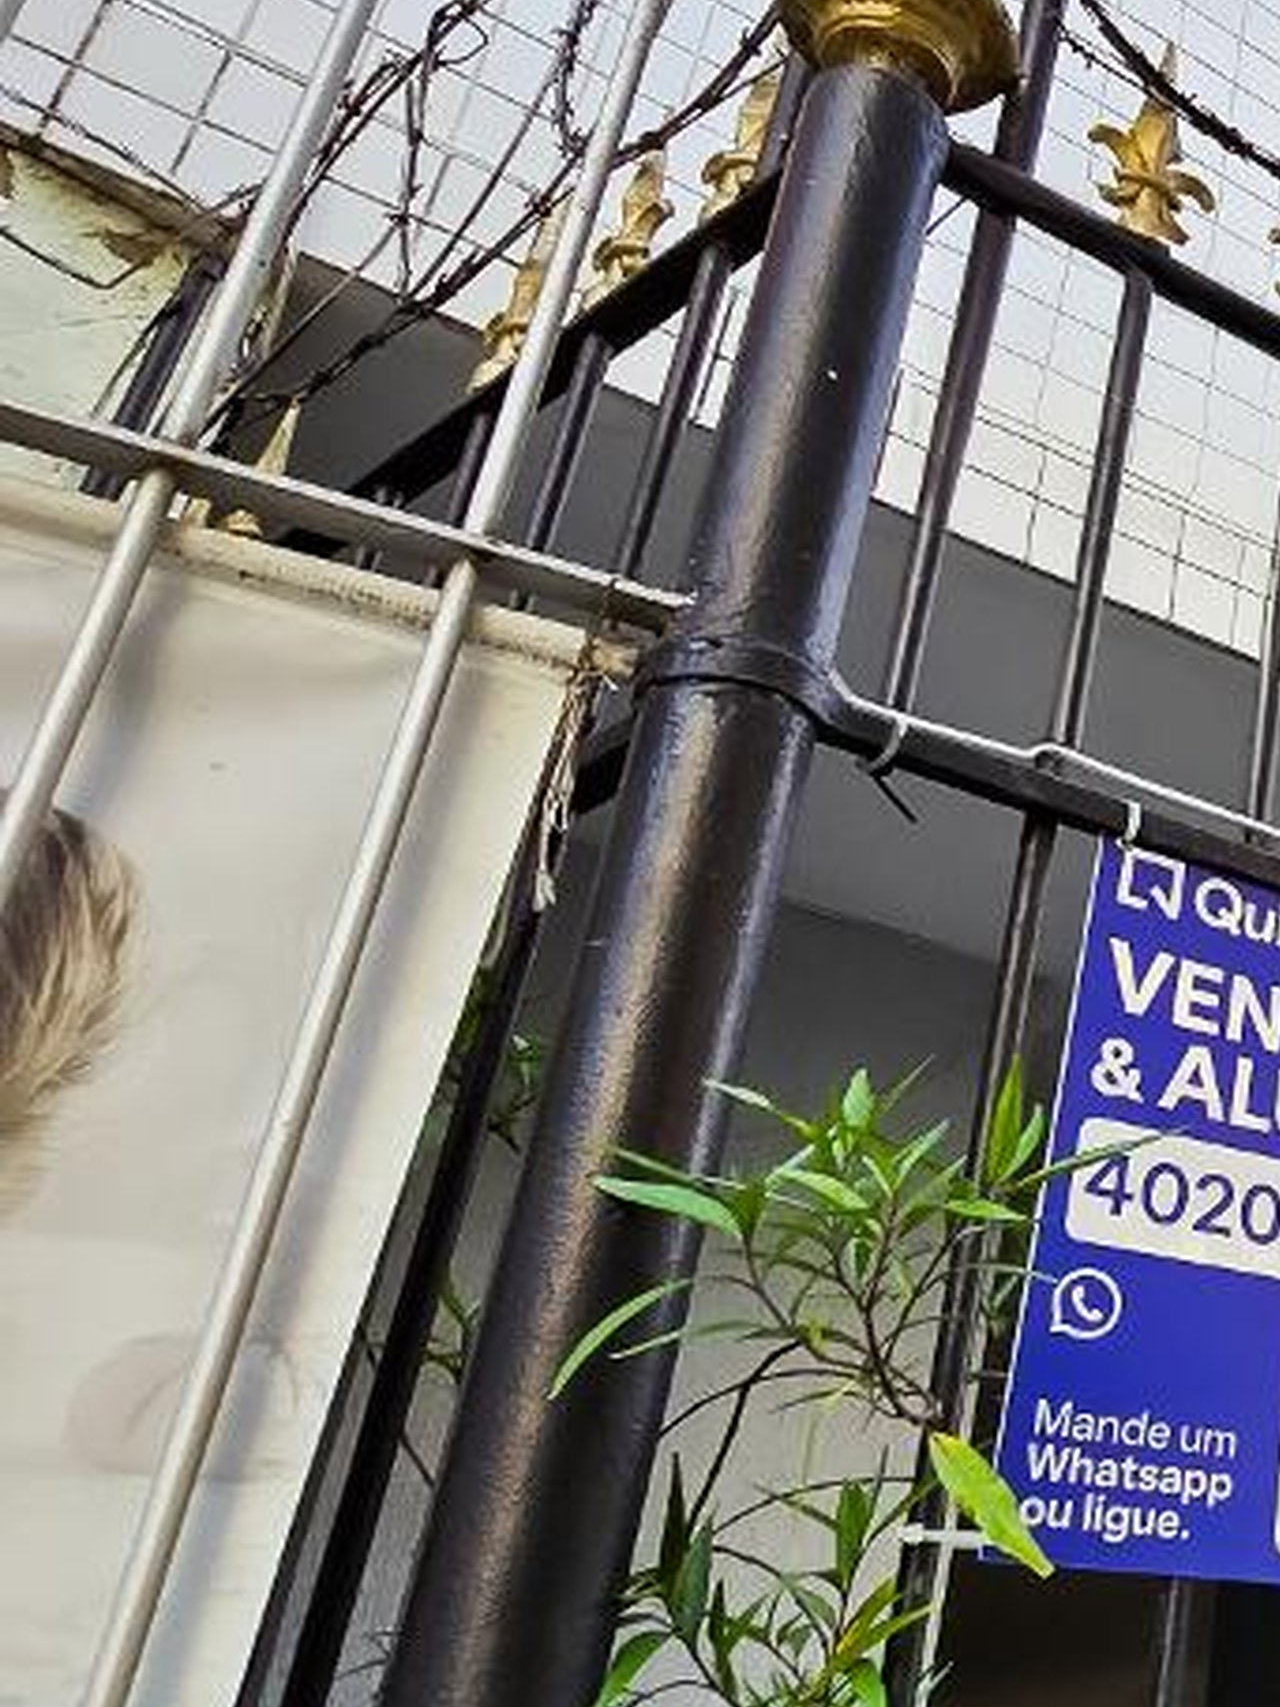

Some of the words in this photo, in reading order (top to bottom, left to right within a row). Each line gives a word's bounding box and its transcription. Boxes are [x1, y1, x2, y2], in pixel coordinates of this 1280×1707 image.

[1090, 1038, 1143, 1103] &
[1033, 1397, 1171, 1452] Mande
[1178, 1425, 1238, 1459] um
[1027, 1443, 1233, 1506] Whatsapp
[1019, 1495, 1074, 1530] ou
[1081, 1491, 1192, 1543] ligue.
